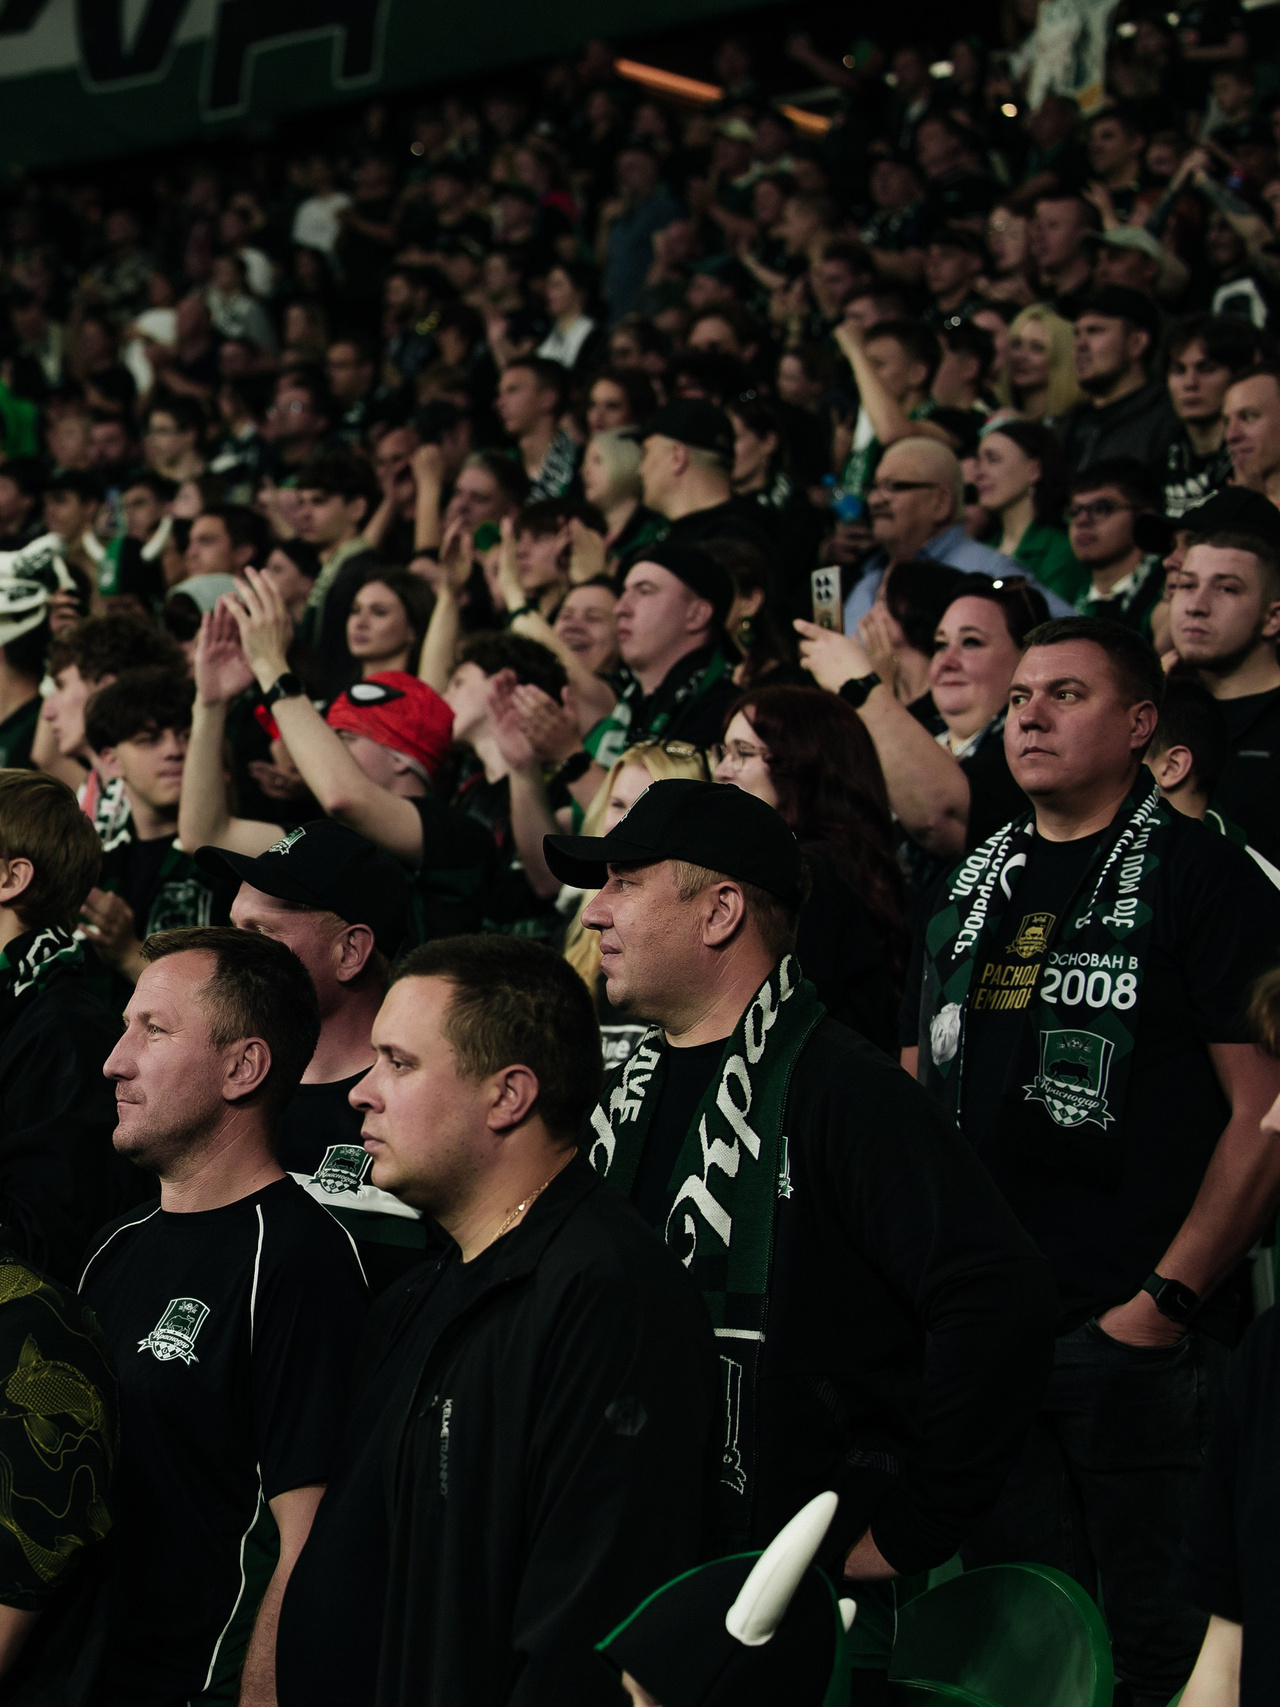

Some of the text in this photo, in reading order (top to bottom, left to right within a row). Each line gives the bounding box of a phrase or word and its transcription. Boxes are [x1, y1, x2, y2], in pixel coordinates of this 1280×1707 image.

[1048, 952, 1124, 969] ОСНОВАН
[980, 962, 1041, 986] РАСНОД
[1040, 967, 1138, 1011] 2008
